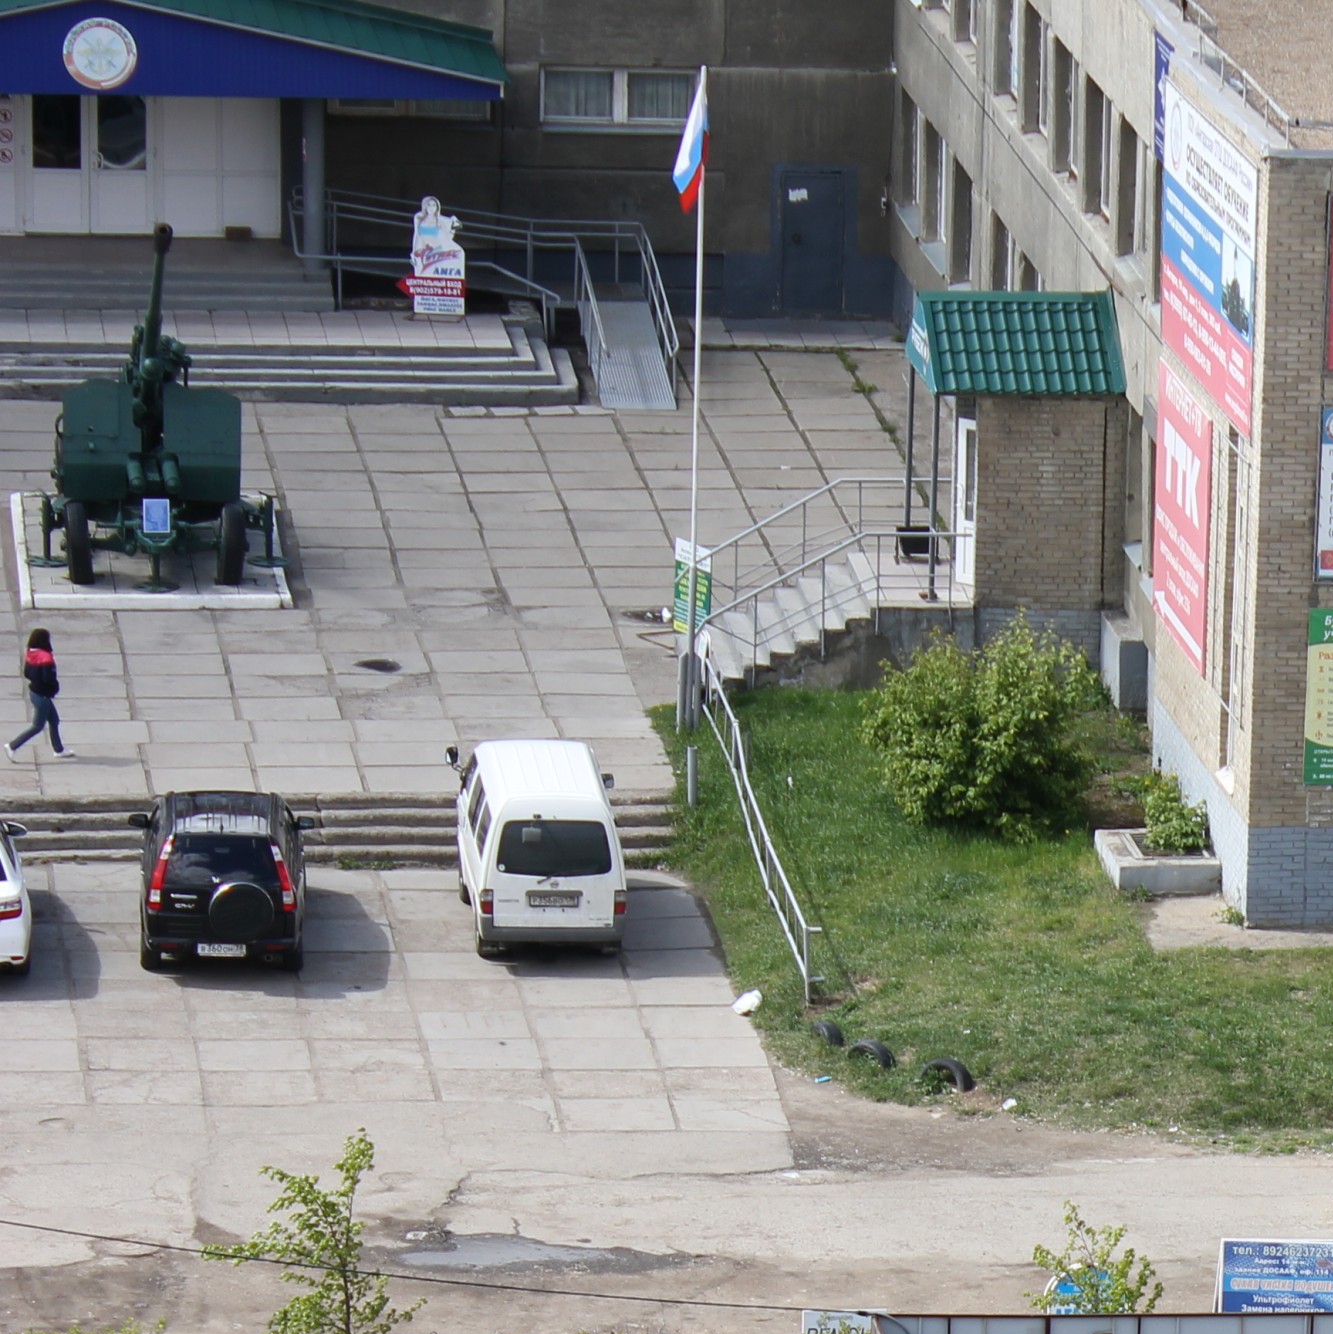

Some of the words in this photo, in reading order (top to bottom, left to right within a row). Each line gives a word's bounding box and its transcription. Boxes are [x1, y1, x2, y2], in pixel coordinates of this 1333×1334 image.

[1163, 416, 1201, 530] ТТК
[1233, 1246, 1259, 1255] тел.:
[1263, 1246, 1333, 1257] 89246237231
